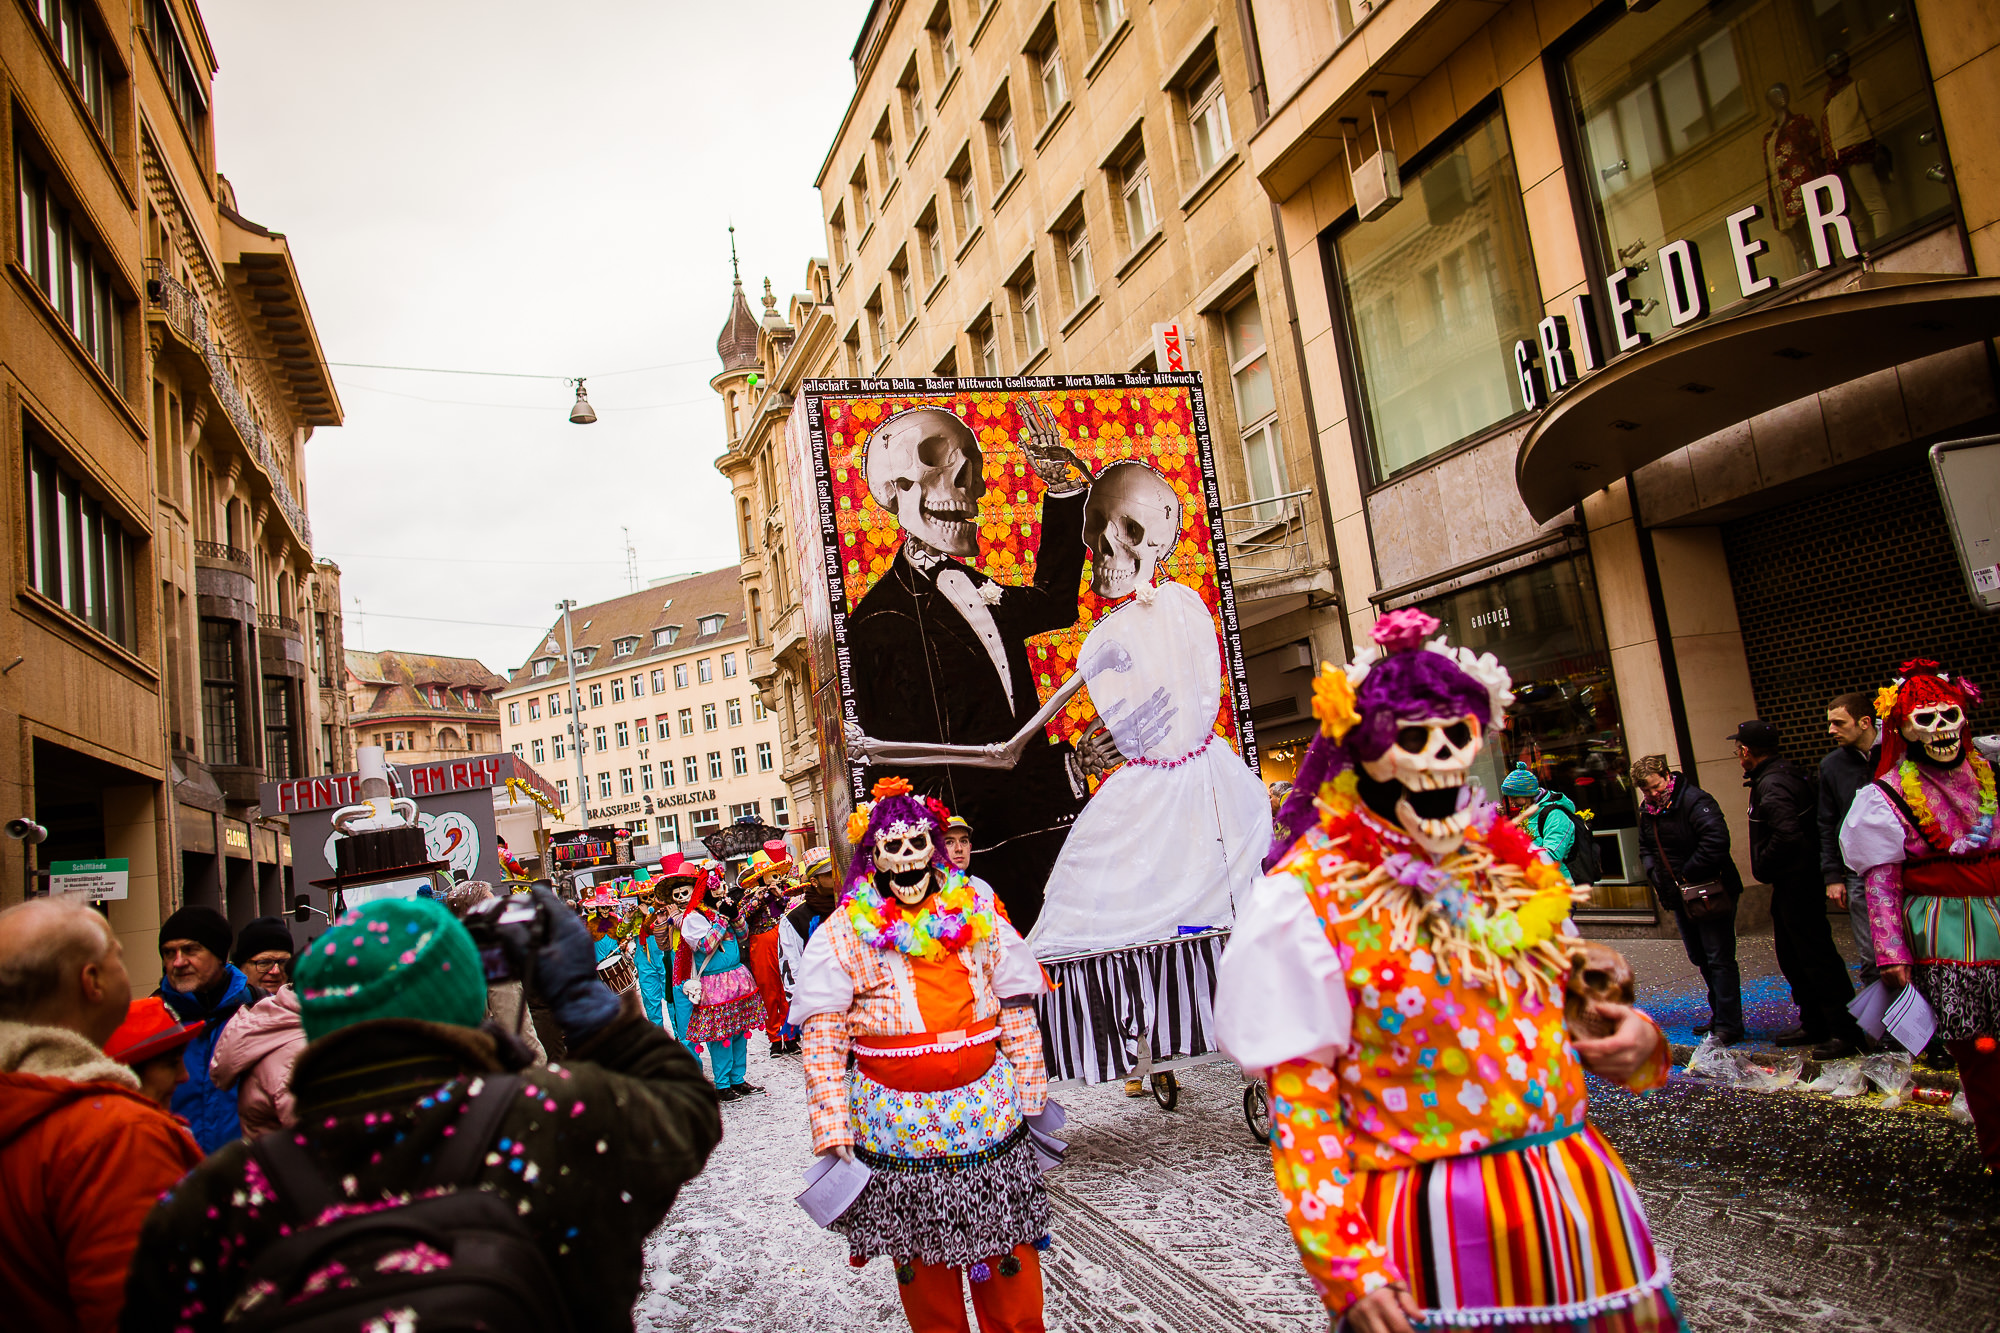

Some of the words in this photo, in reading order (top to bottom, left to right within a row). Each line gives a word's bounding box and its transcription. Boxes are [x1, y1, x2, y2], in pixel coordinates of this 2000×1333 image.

[1514, 174, 1861, 412] GRIEDER
[860, 379, 889, 391] Morta
[893, 378, 915, 390] Bella
[926, 377, 954, 390] Basler
[958, 377, 1002, 389] Mittwuch
[1005, 376, 1055, 388] Gsellschaft
[1065, 375, 1092, 387] Morta
[1095, 374, 1115, 386] Bella
[1125, 374, 1151, 385] Basler
[1154, 372, 1194, 384] Mittwuch
[807, 398, 819, 427] Basler
[811, 430, 828, 477] Mittwuch
[1199, 434, 1215, 478] Mittwuch
[817, 481, 835, 534] Gsellschaft
[1206, 481, 1219, 508] Basler
[1212, 518, 1223, 540] Bella
[825, 545, 838, 576] Morta
[1217, 543, 1229, 570] Morta
[829, 578, 841, 602] Bella
[1220, 580, 1237, 631] Gsellschaft
[1471, 607, 1509, 629] GRIEDER
[834, 612, 846, 644] Basler
[838, 646, 852, 696] Mittwuch
[1229, 634, 1246, 679] Mittwuch
[845, 699, 858, 723] Gsell
[1238, 682, 1250, 711] Basler
[1241, 720, 1254, 744] Bella
[1247, 745, 1260, 775] Morta
[410, 766, 446, 796] AM
[450, 758, 500, 791] RHY
[852, 767, 867, 799] Morta
[586, 801, 641, 820] BRASSERIE
[657, 789, 717, 809] BASELSTAB
[226, 828, 248, 848] GLOBUS
[555, 844, 586, 860] MORTA
[586, 841, 613, 857] BELLA
